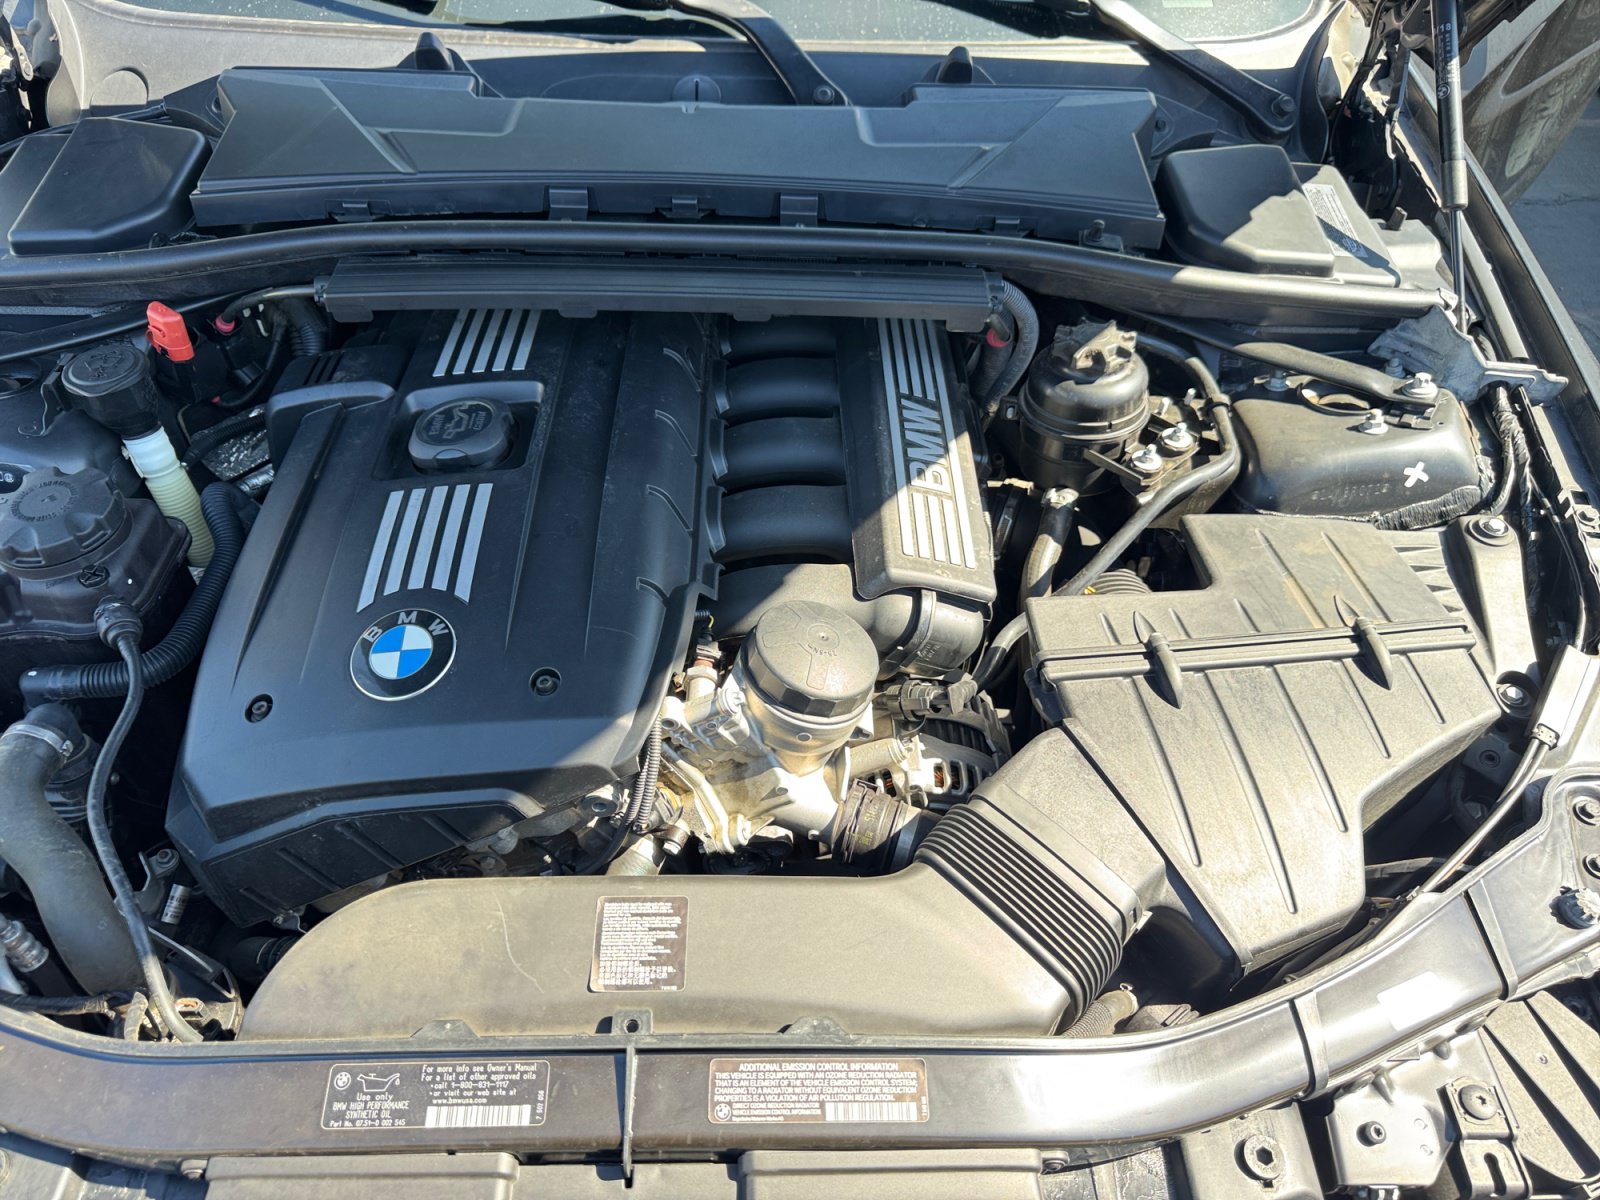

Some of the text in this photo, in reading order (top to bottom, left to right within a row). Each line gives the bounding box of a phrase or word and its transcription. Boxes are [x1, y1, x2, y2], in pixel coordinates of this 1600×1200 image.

[900, 398, 951, 494] BMW
[363, 610, 450, 643] BMW
[456, 1064, 470, 1072] info
[487, 1064, 511, 1072] Owner's
[515, 1062, 536, 1071] Manual
[738, 1063, 898, 1071] ADDITIONAL EMISSION CONTROL INFORMATION
[421, 1073, 433, 1081] For
[444, 1072, 455, 1080] list
[470, 1072, 488, 1080] other
[491, 1072, 520, 1081] approved
[523, 1072, 536, 1080] oils
[356, 1092, 393, 1102] Use only
[332, 1100, 410, 1110] BMW HIGH PERFORMANCE
[345, 1110, 392, 1119] SYNTHETIC OIL
